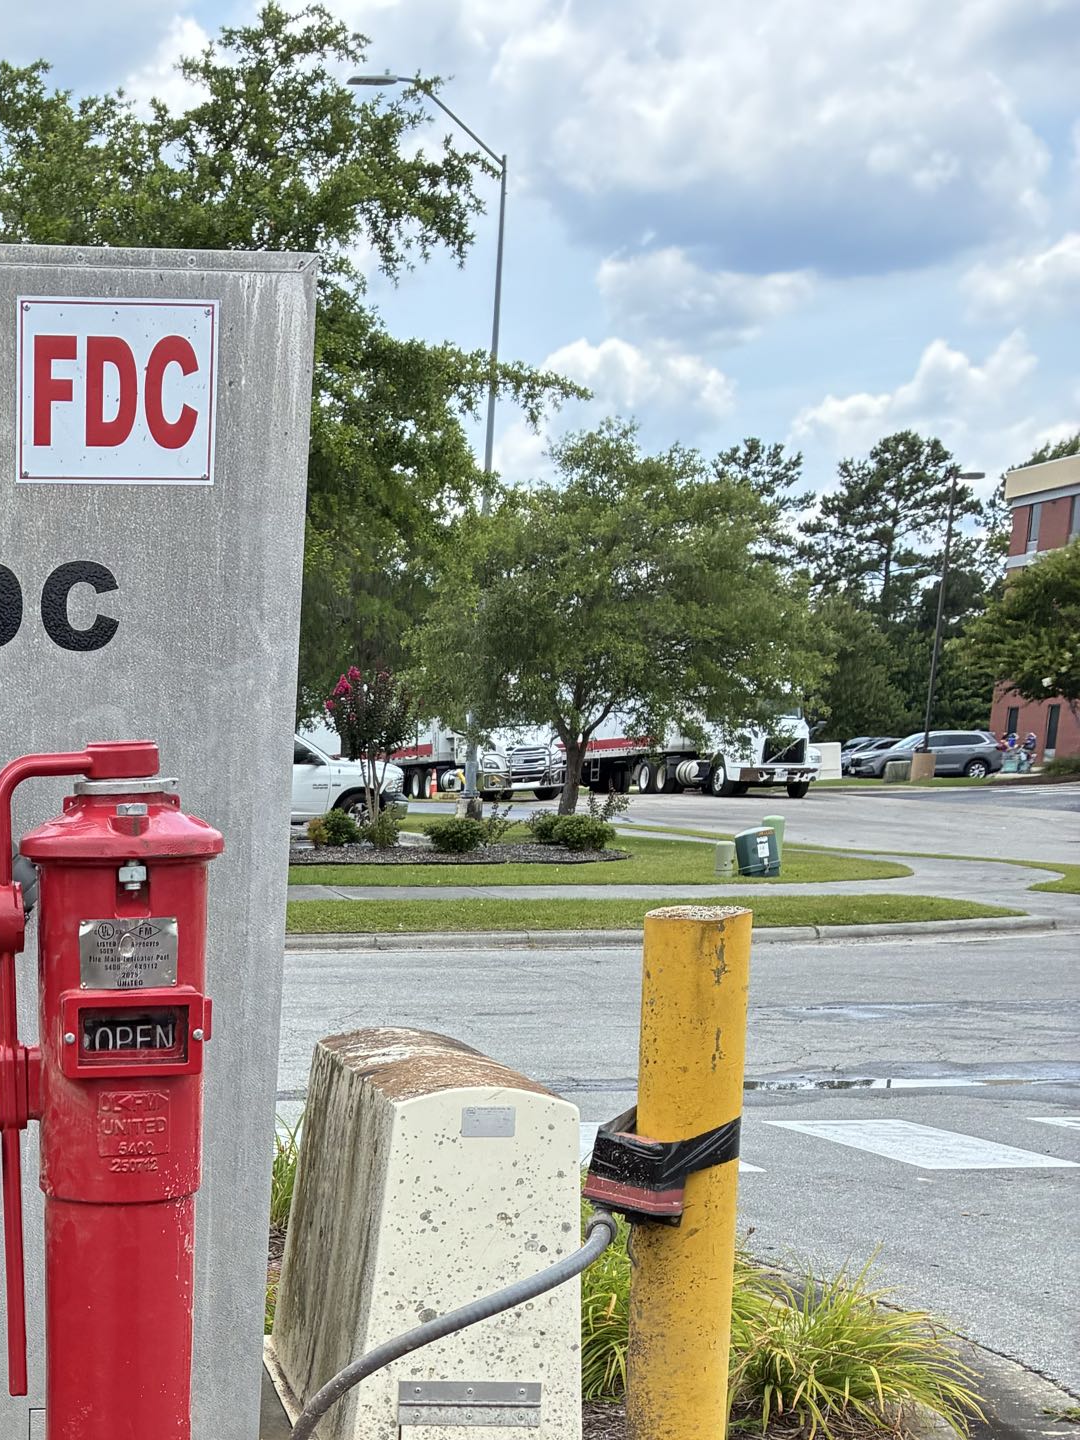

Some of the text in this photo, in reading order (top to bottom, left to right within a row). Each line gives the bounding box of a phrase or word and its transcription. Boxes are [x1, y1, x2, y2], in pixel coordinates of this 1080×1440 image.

[32, 333, 201, 450] FDC
[95, 1024, 173, 1051] OPEN
[101, 1116, 168, 1136] UNITED
